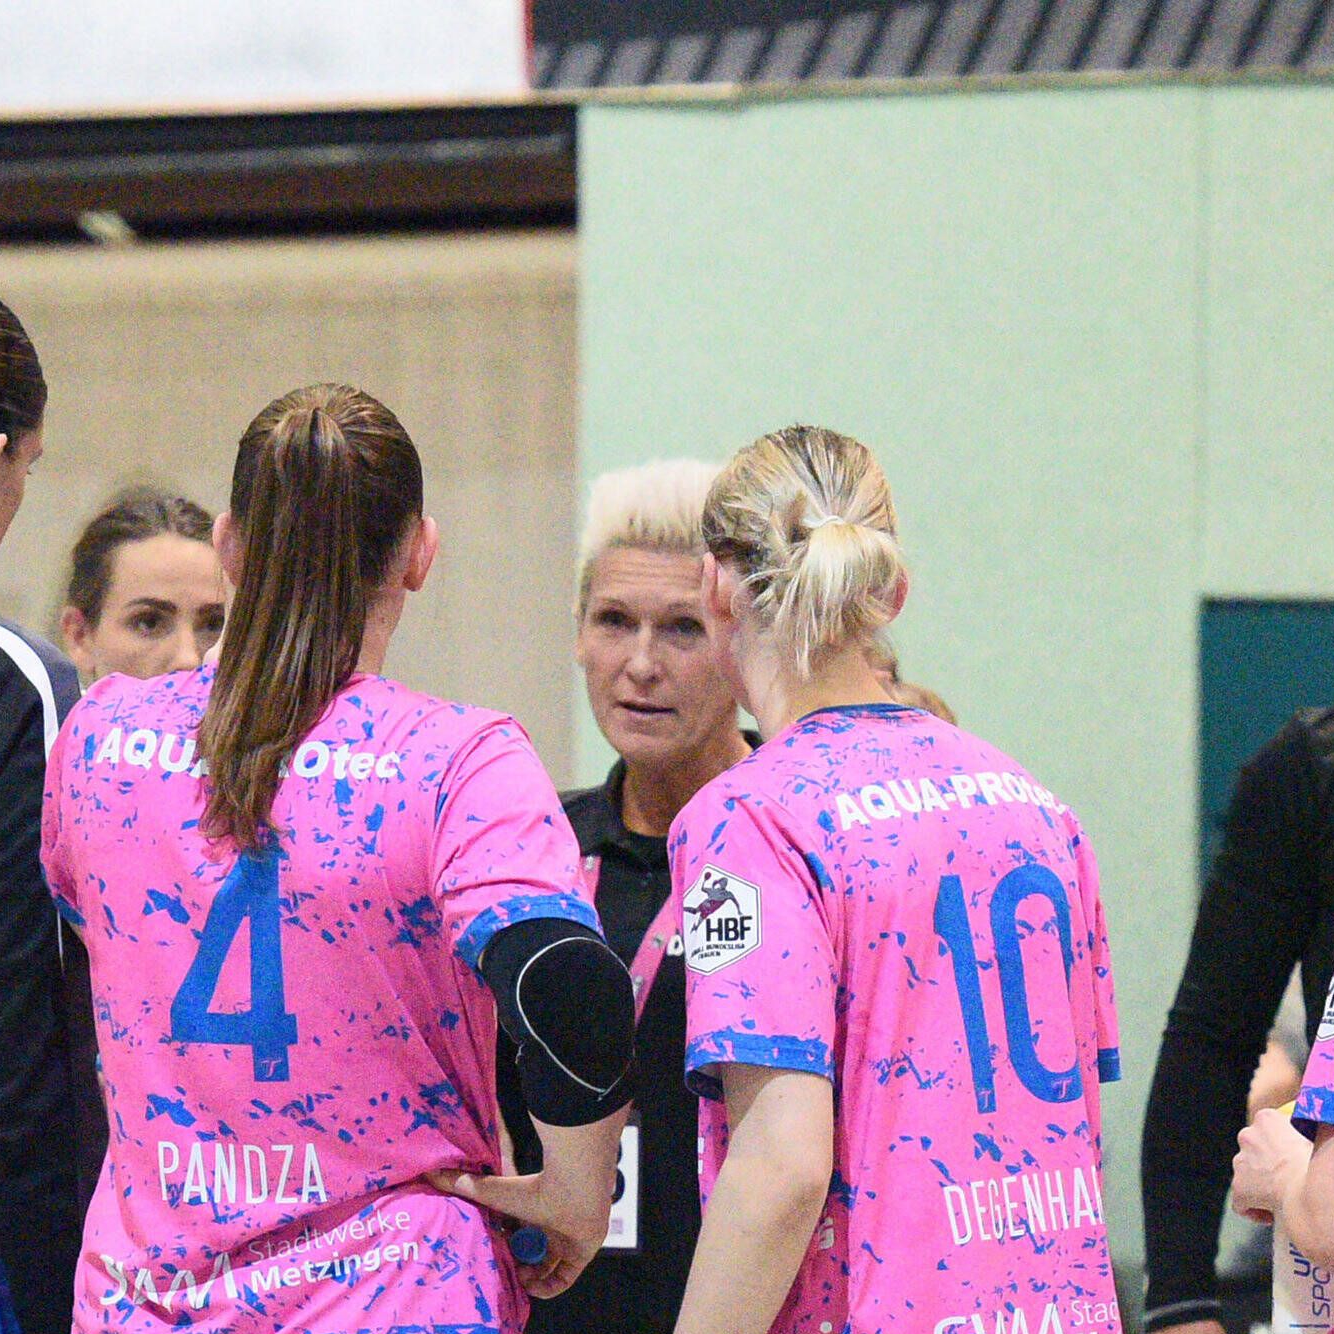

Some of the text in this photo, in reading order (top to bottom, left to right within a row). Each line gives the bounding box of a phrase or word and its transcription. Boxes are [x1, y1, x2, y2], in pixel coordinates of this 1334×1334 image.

[705, 915, 753, 942] HBF
[170, 838, 298, 1082] 4
[934, 864, 1084, 1114] 10
[157, 1141, 329, 1205] PANDZA
[247, 1208, 412, 1266] Stadtwerke
[249, 1238, 421, 1296] Metzingen
